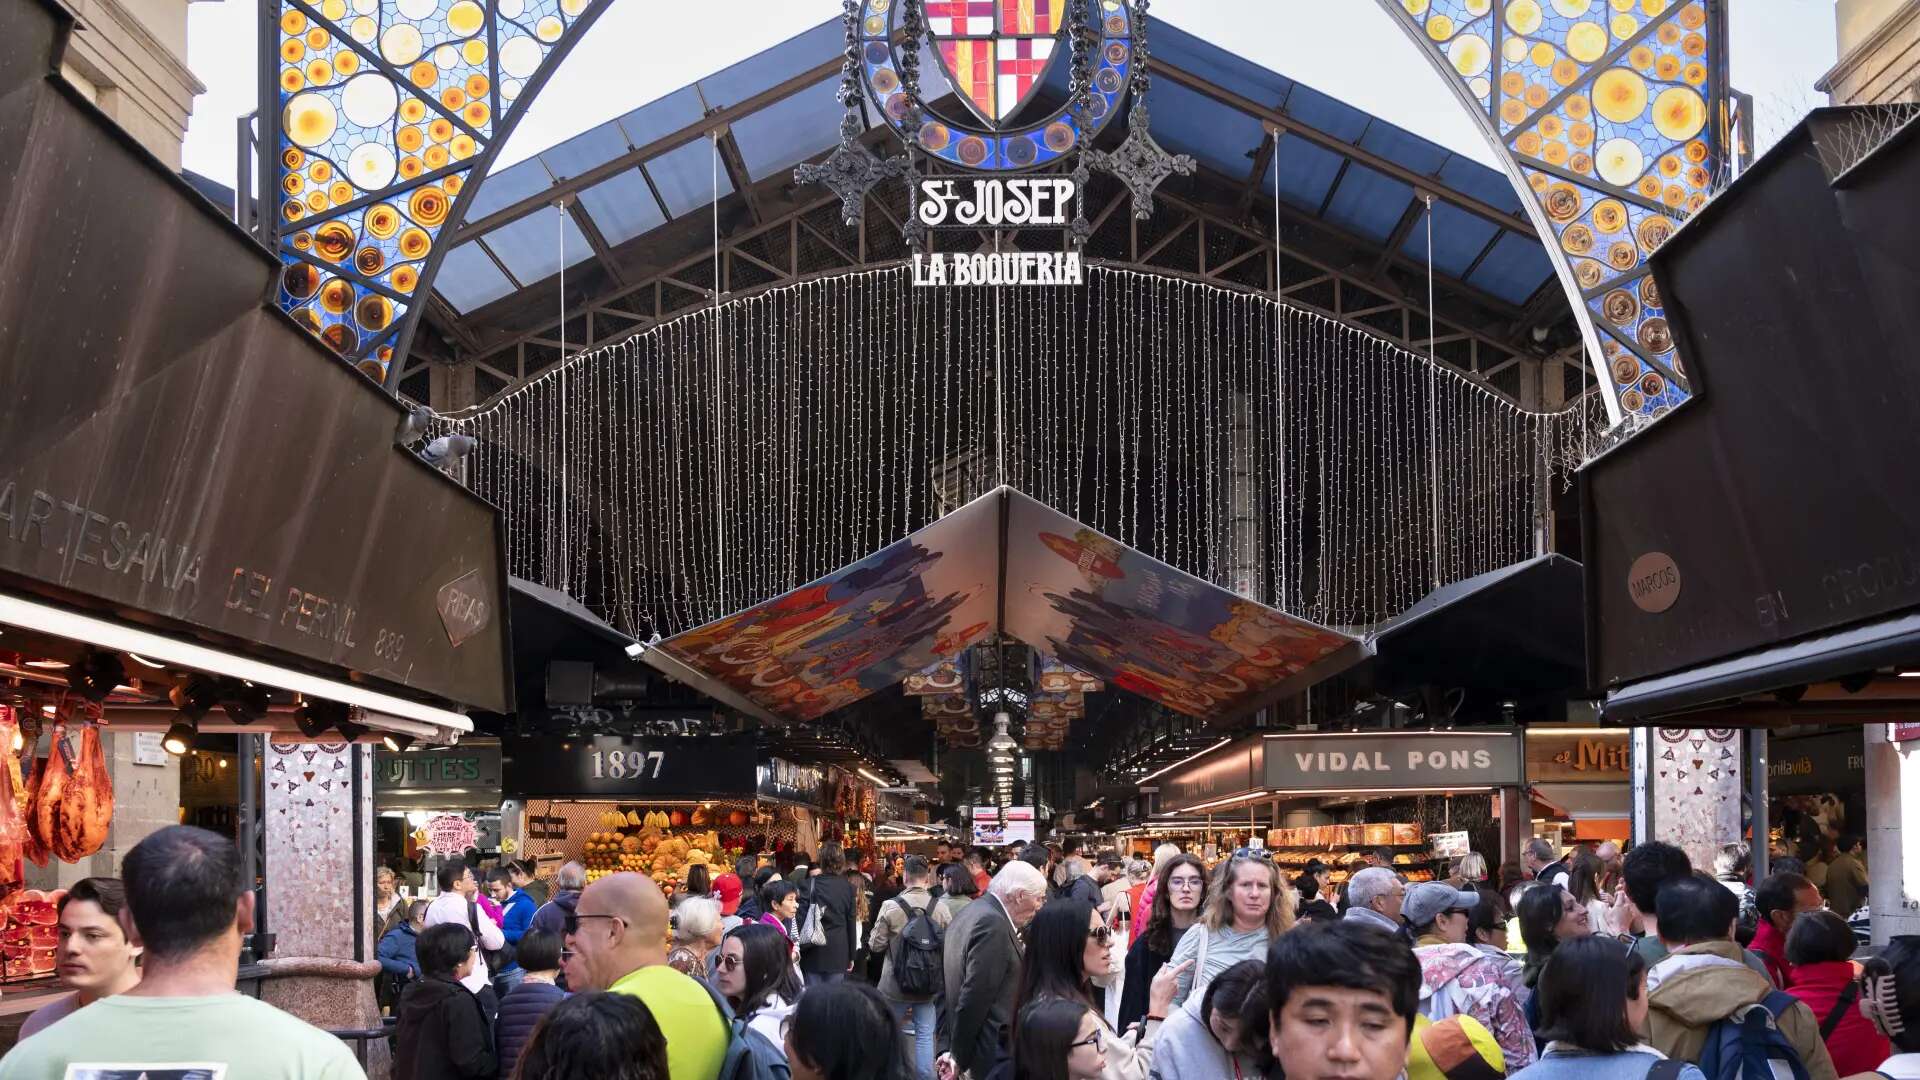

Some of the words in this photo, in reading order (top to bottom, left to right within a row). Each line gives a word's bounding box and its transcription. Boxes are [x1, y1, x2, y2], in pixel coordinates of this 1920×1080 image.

[955, 179, 1075, 225] JOSEP
[913, 253, 946, 286] LA
[953, 252, 1083, 286] BOQUERIA
[1631, 566, 1676, 600] MARCOS
[592, 750, 665, 779] 1897
[1295, 752, 1391, 772] VIDAL
[1408, 750, 1491, 770] PONS
